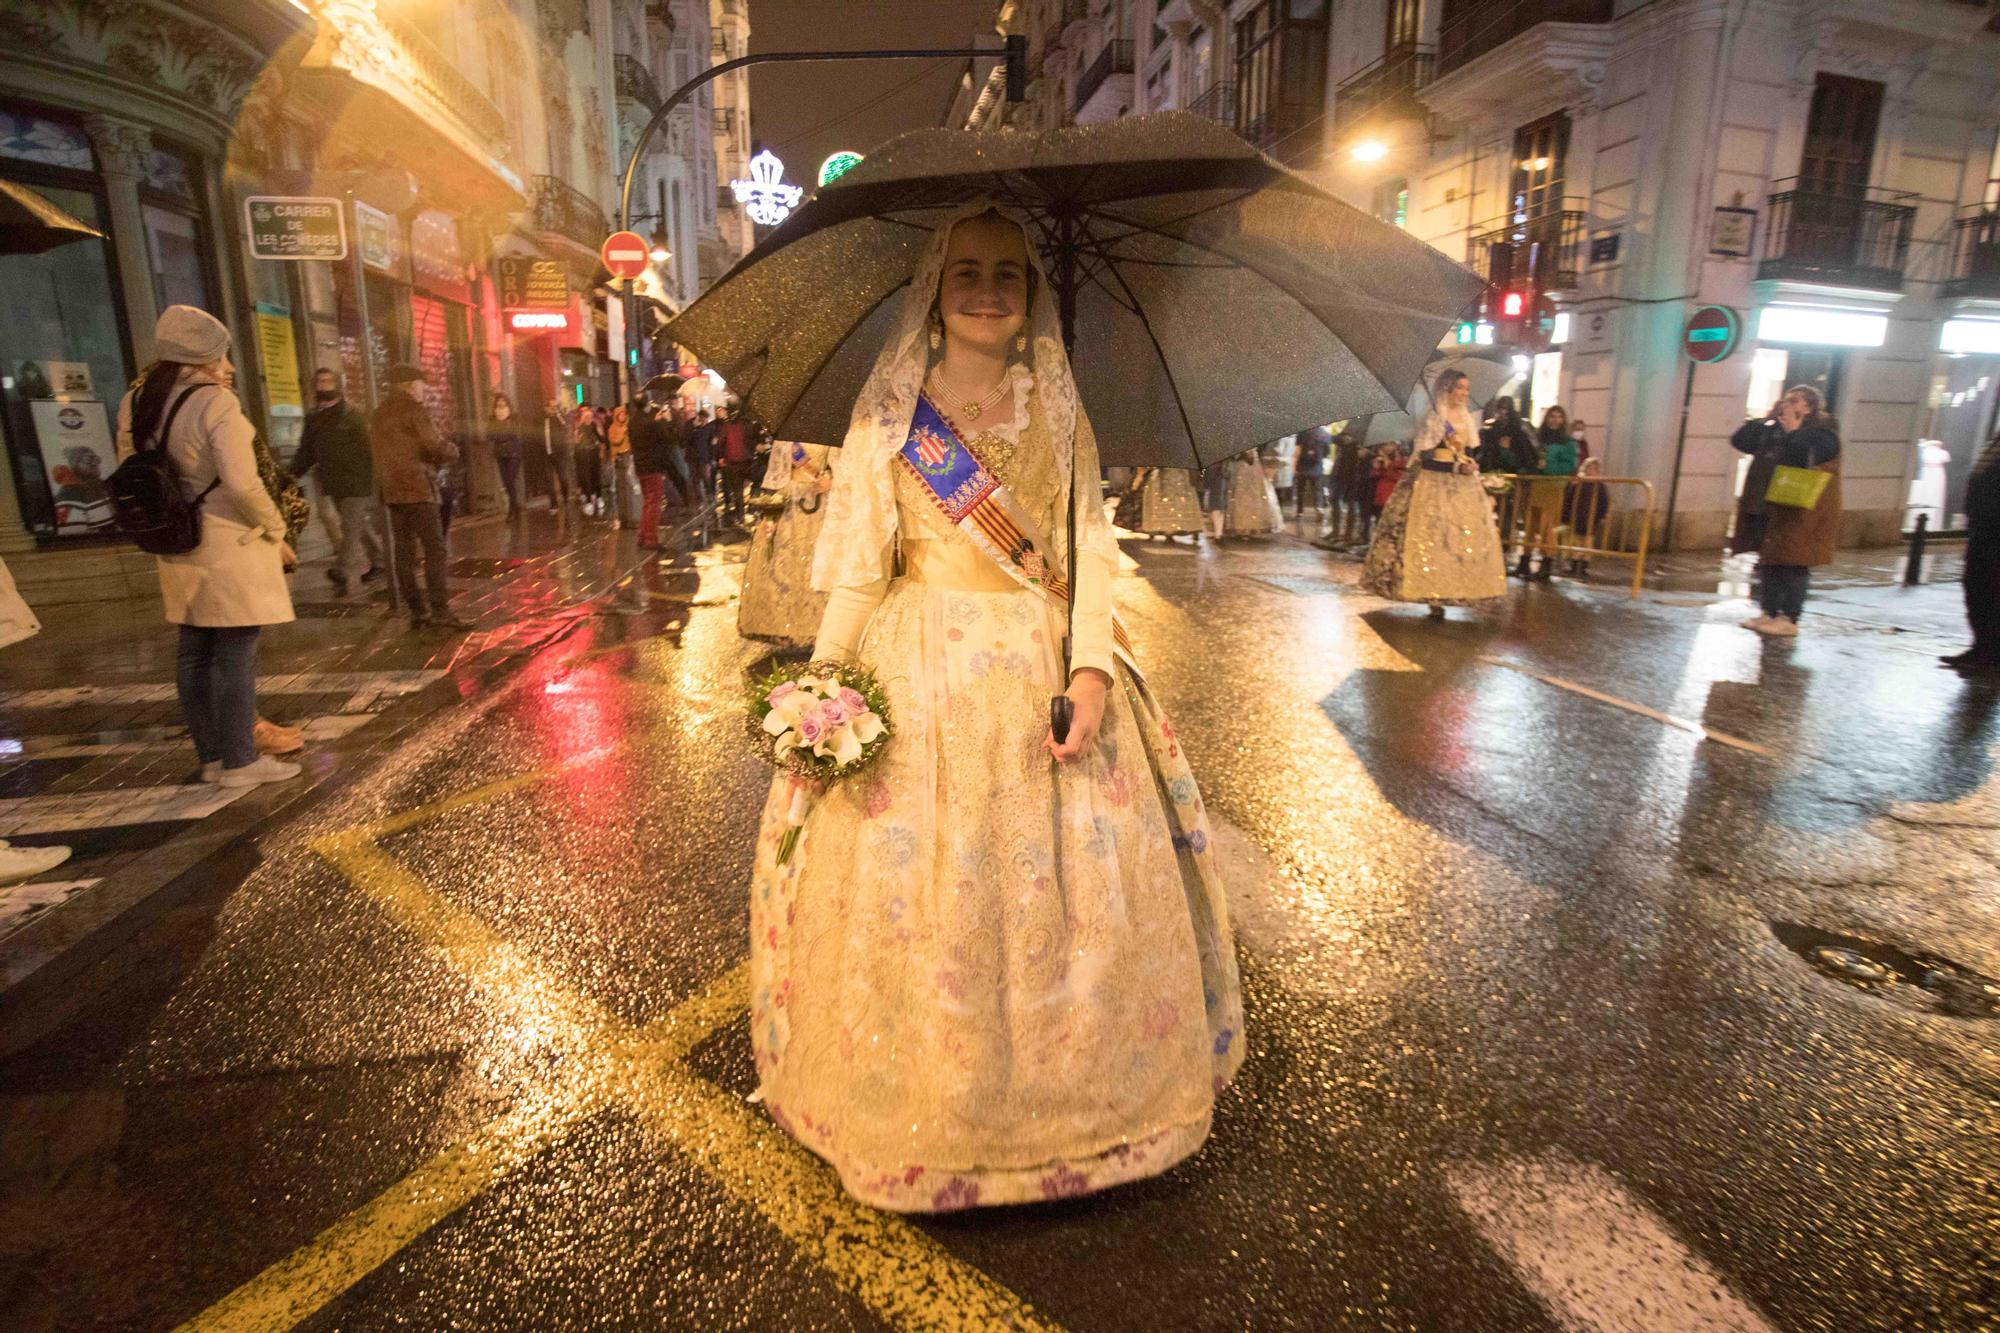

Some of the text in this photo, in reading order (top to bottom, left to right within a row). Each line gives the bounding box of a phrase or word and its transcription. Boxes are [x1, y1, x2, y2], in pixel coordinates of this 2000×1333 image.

[274, 206, 331, 216] CARRER
[287, 221, 304, 230] DE
[257, 234, 278, 245] LES
[502, 261, 519, 305] ORO
